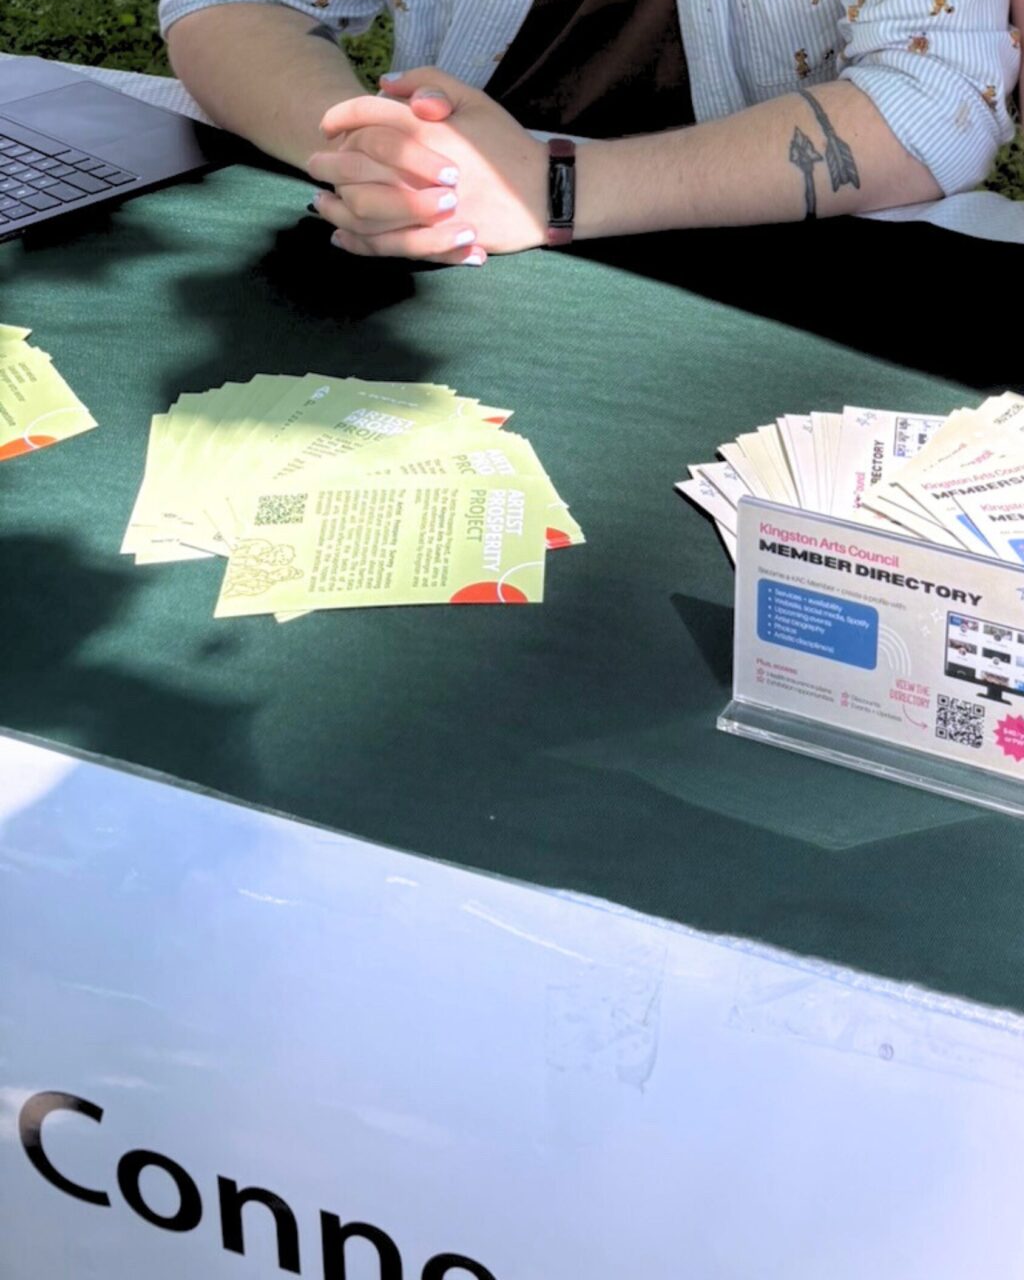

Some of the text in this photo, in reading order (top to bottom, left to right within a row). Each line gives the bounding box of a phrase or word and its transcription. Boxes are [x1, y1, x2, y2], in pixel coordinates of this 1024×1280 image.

[333, 422, 384, 441] PROJE
[871, 440, 885, 486] RECTORY
[464, 489, 487, 542] PROJECT
[759, 521, 900, 568] Kingston Arts Council
[758, 537, 852, 574] MEMBER
[854, 562, 983, 608] DIRECTORY
